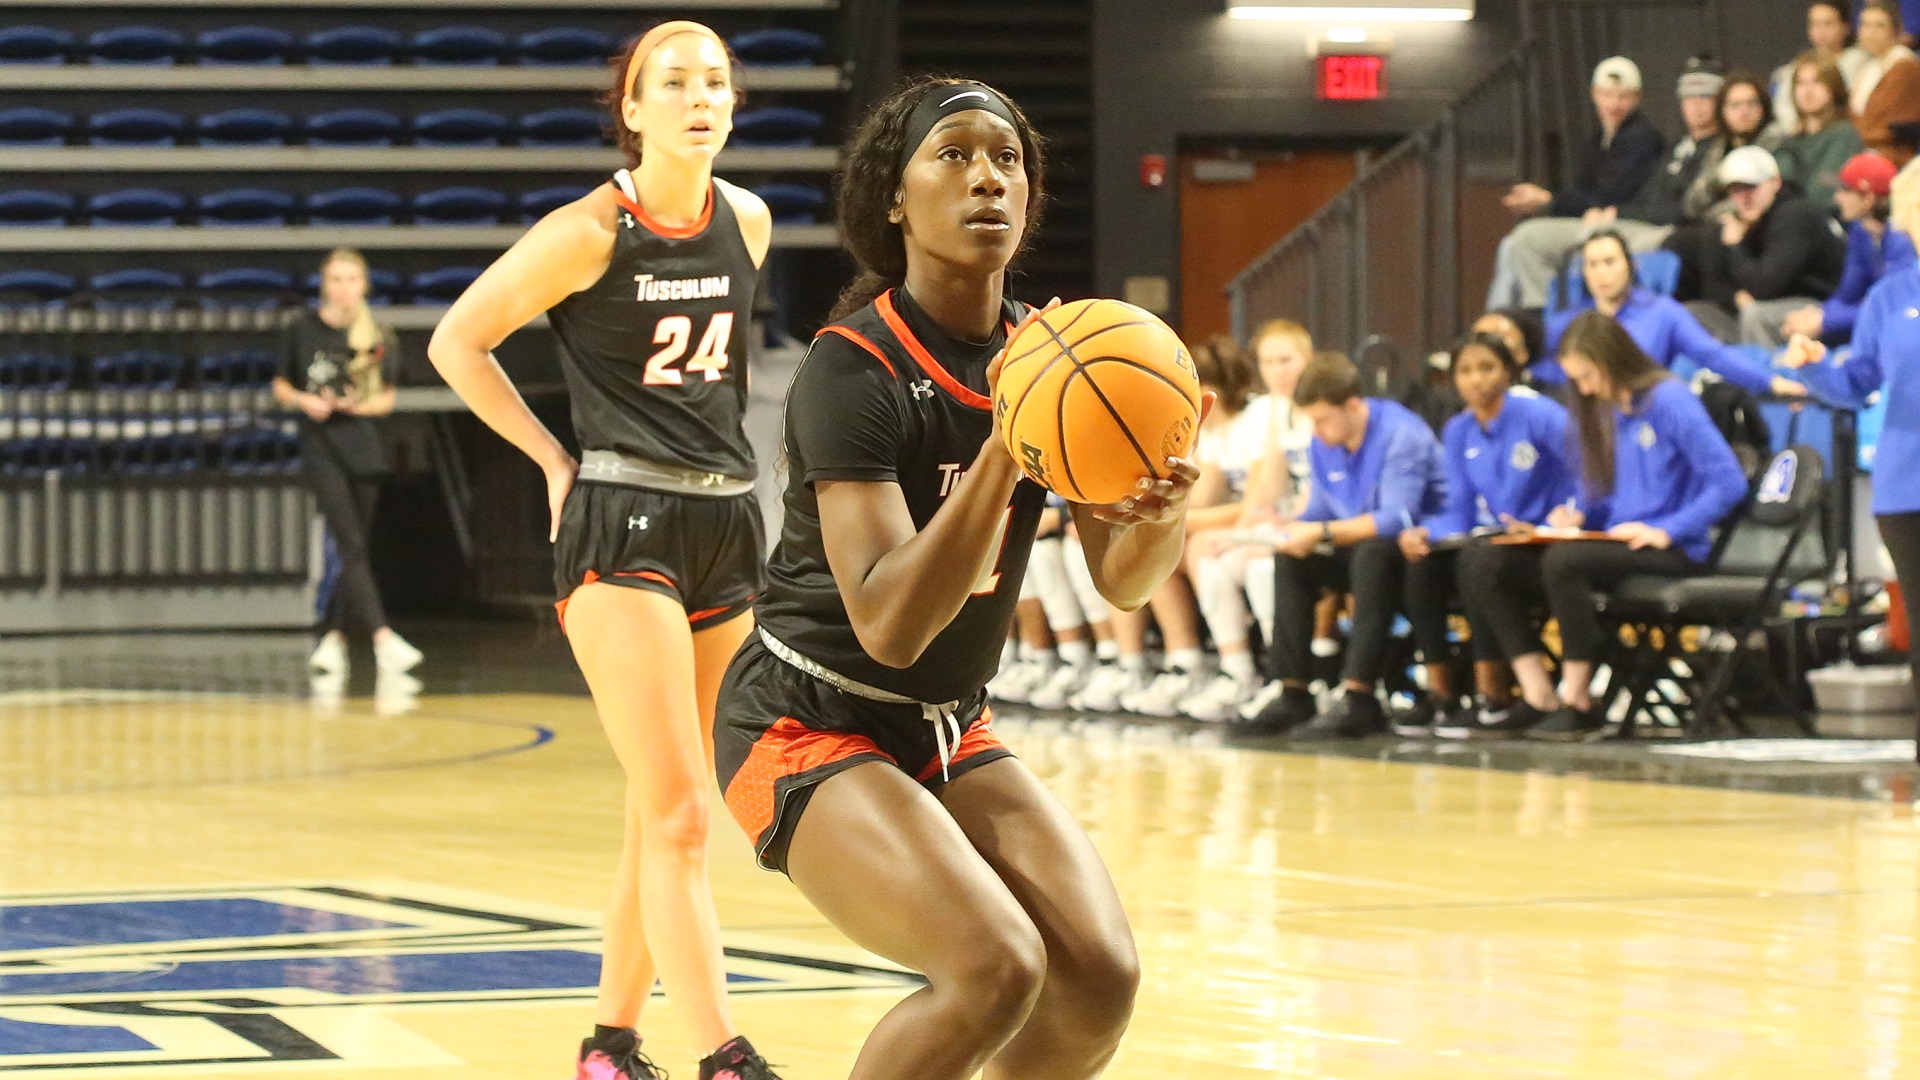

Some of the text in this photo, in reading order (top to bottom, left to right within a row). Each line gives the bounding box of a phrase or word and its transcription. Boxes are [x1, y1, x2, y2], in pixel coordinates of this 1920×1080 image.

[1325, 56, 1382, 98] EXIT
[634, 273, 730, 301] TUSCULUM
[642, 311, 734, 386] 24
